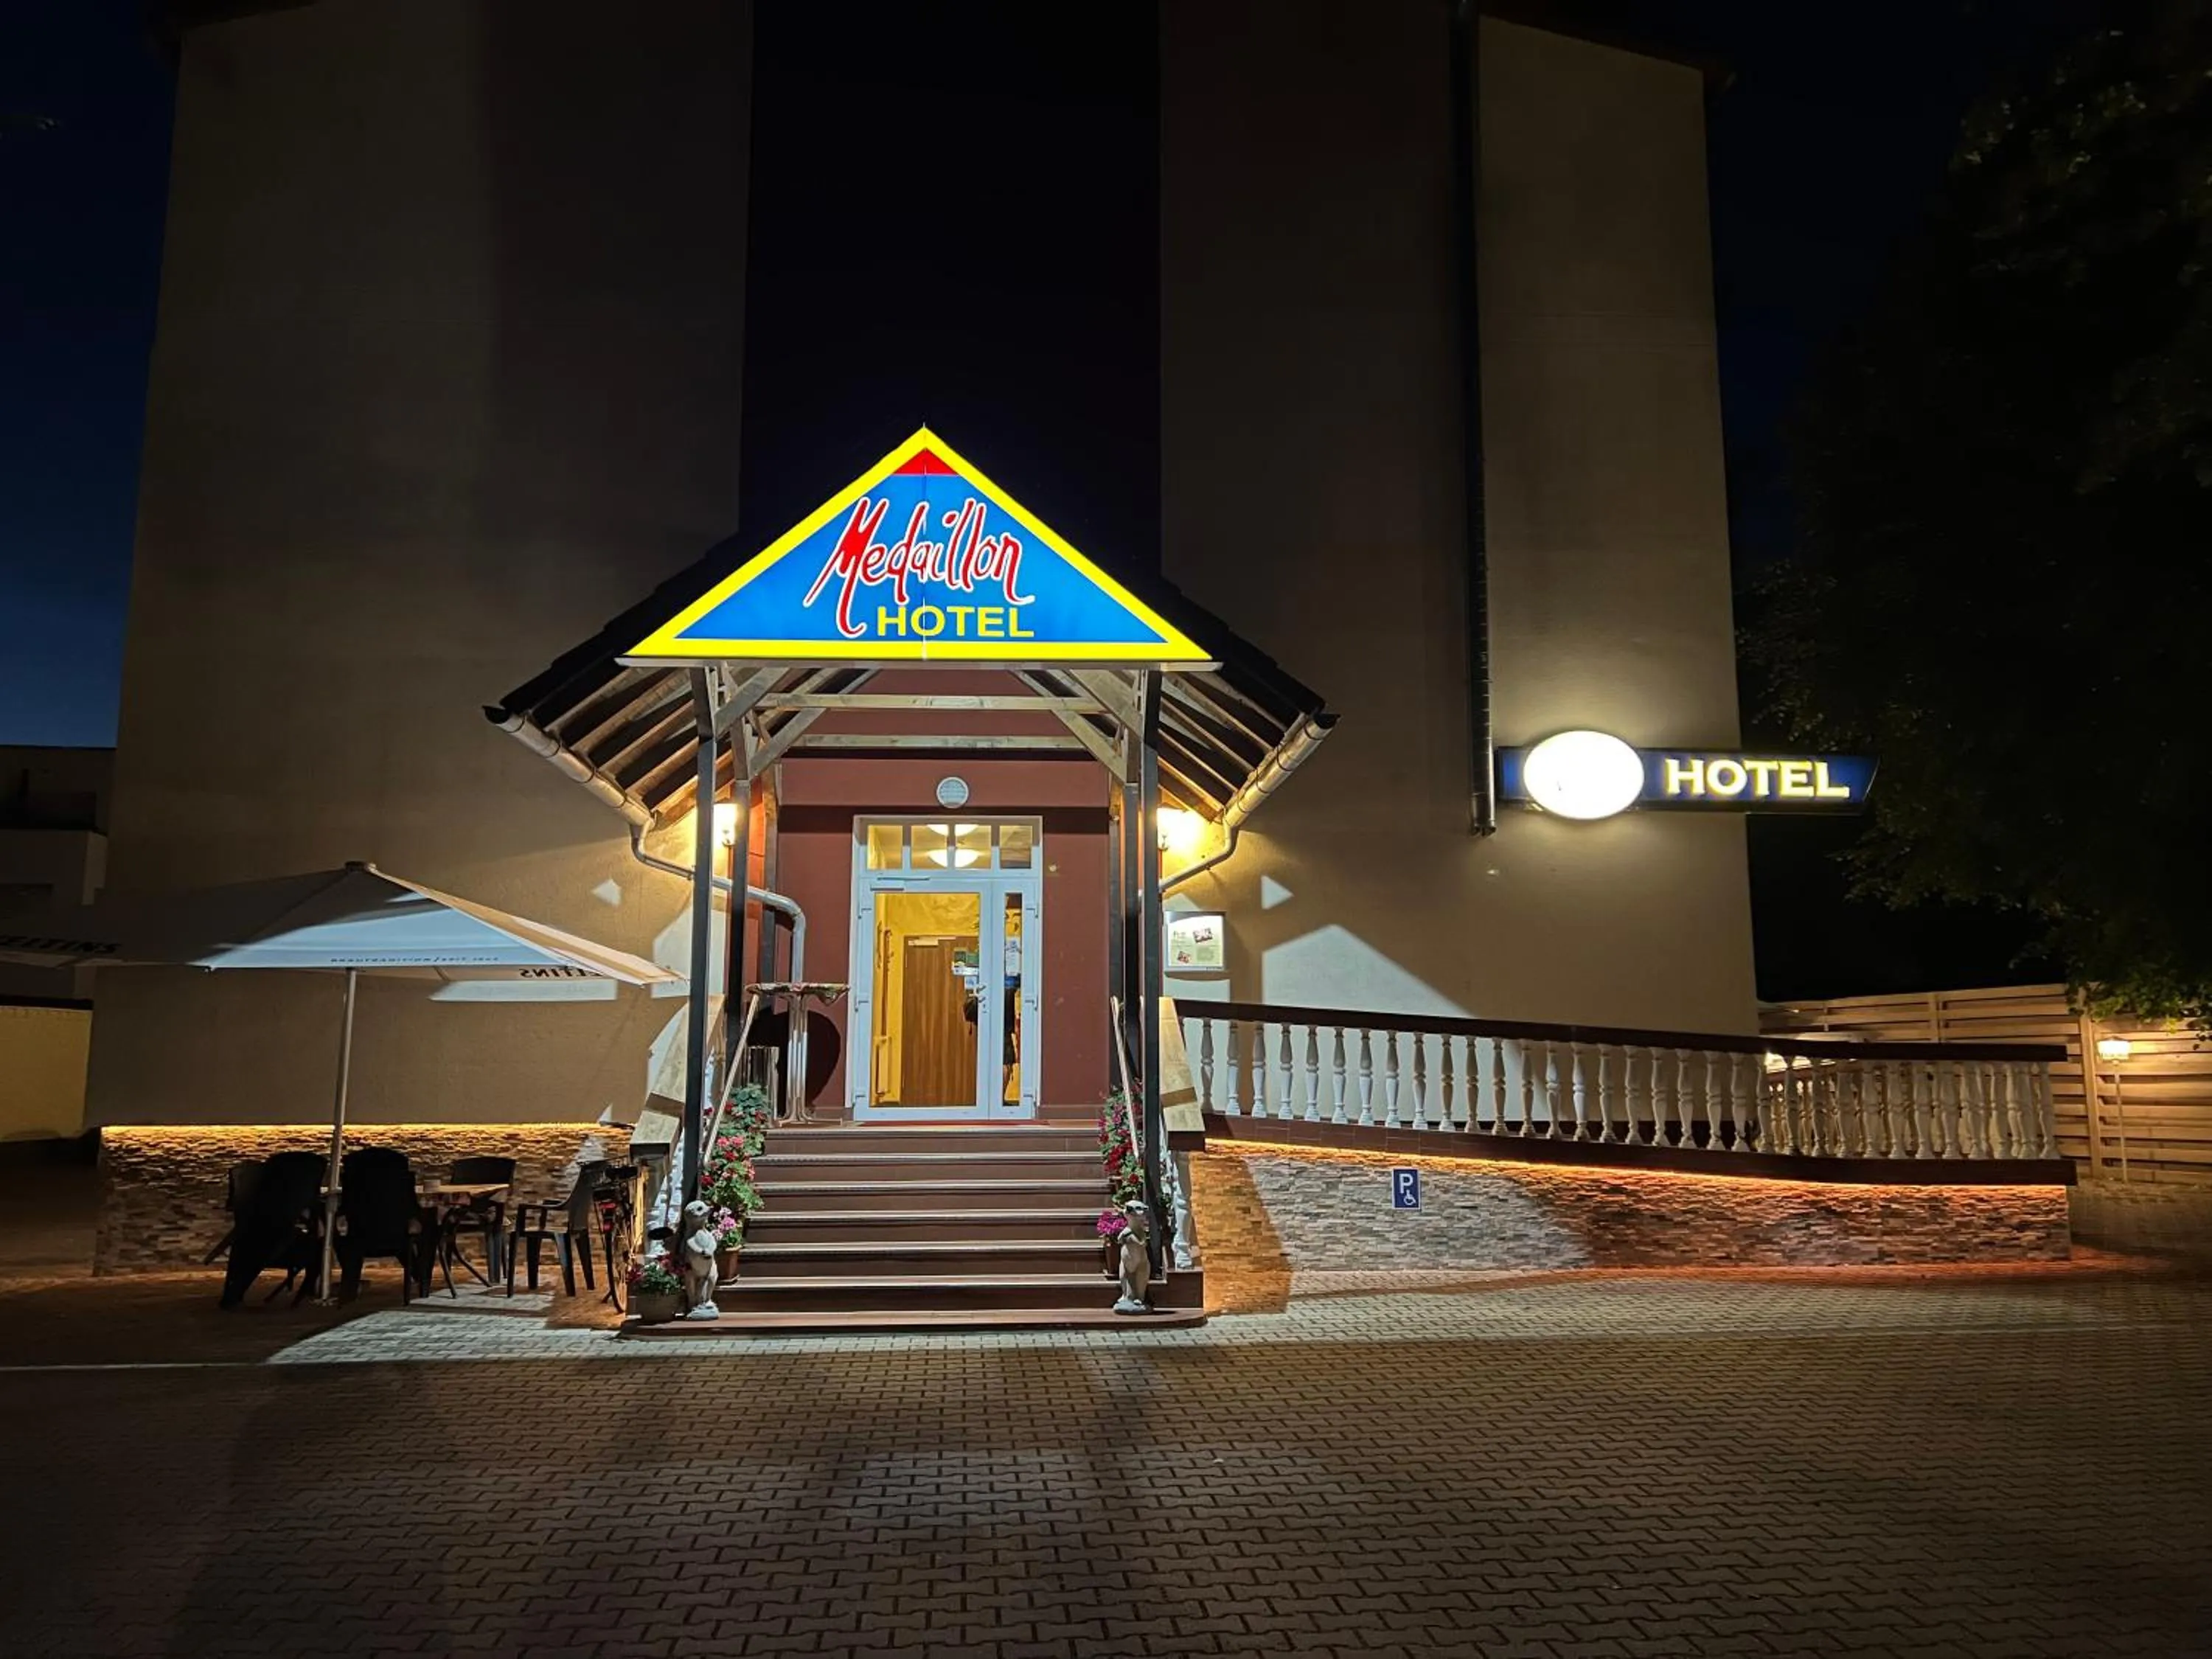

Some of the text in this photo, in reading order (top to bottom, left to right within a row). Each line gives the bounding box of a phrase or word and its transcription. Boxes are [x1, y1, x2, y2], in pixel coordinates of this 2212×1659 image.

[803, 497, 1035, 637] Medaillon
[877, 605, 1034, 637] HOTEL
[1664, 758, 1849, 798] HOTEL
[1399, 1173, 1413, 1194] P
